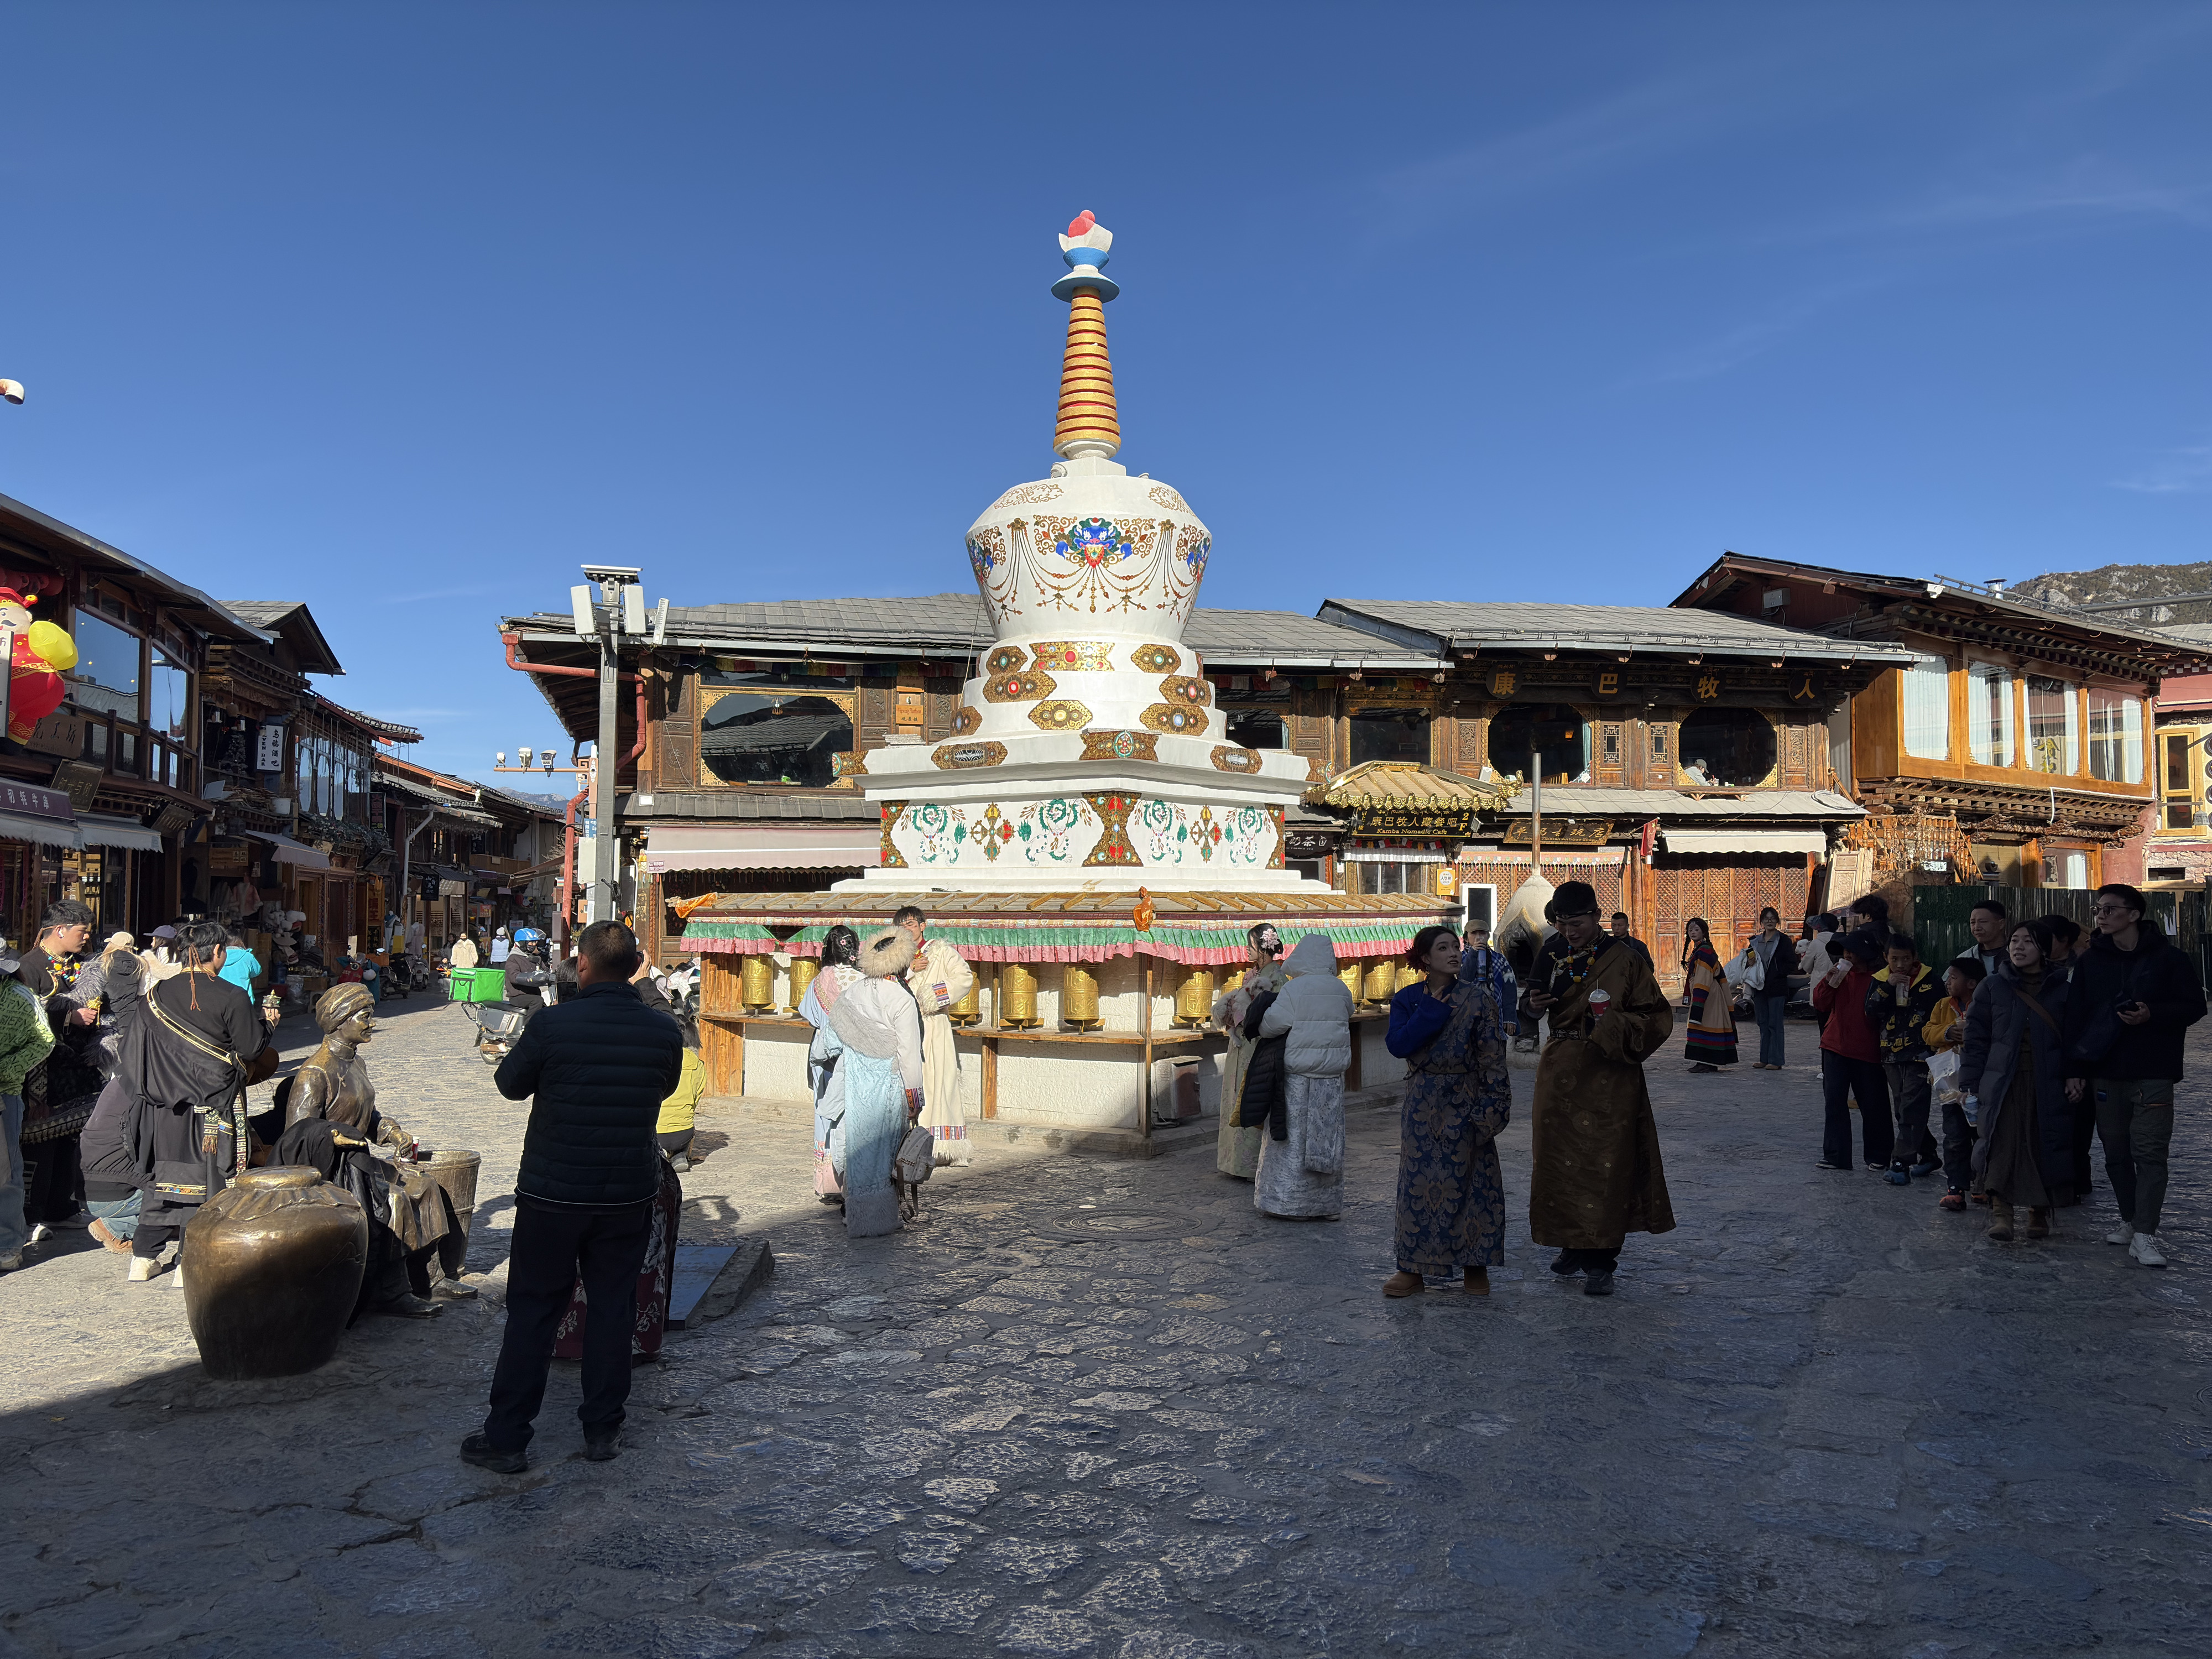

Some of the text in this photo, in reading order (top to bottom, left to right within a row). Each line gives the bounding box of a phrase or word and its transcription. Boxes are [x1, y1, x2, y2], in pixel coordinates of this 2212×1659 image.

[271, 729, 279, 767] 乌鸦酒吧
[0, 788, 49, 810] 切牦牛串
[1370, 816, 1458, 827] 康巴牧人藏餐吧
[1289, 835, 1316, 847] 奶茶
